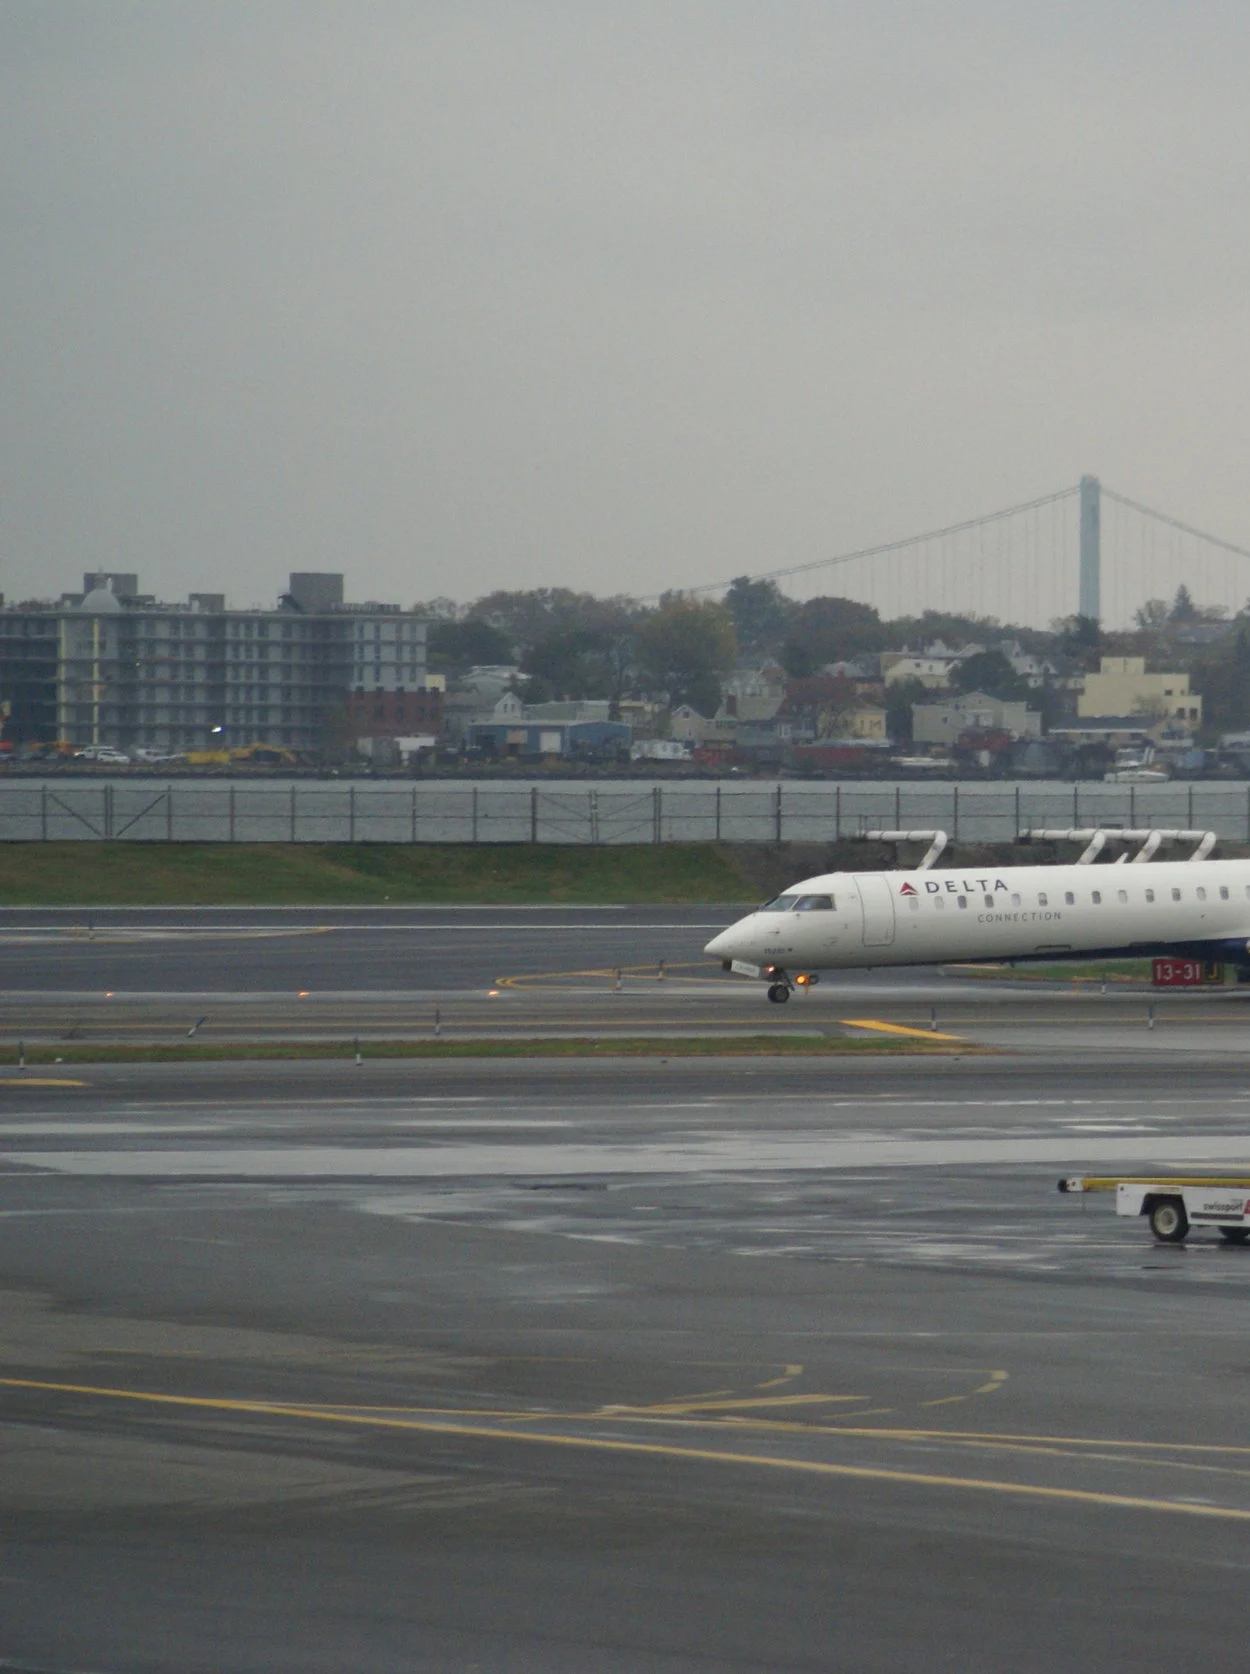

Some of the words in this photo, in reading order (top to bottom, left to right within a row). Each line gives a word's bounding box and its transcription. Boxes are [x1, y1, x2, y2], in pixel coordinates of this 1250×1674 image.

[925, 879, 1009, 894] DELTA
[977, 911, 1063, 923] CONNECTION
[1156, 963, 1200, 980] 13-31
